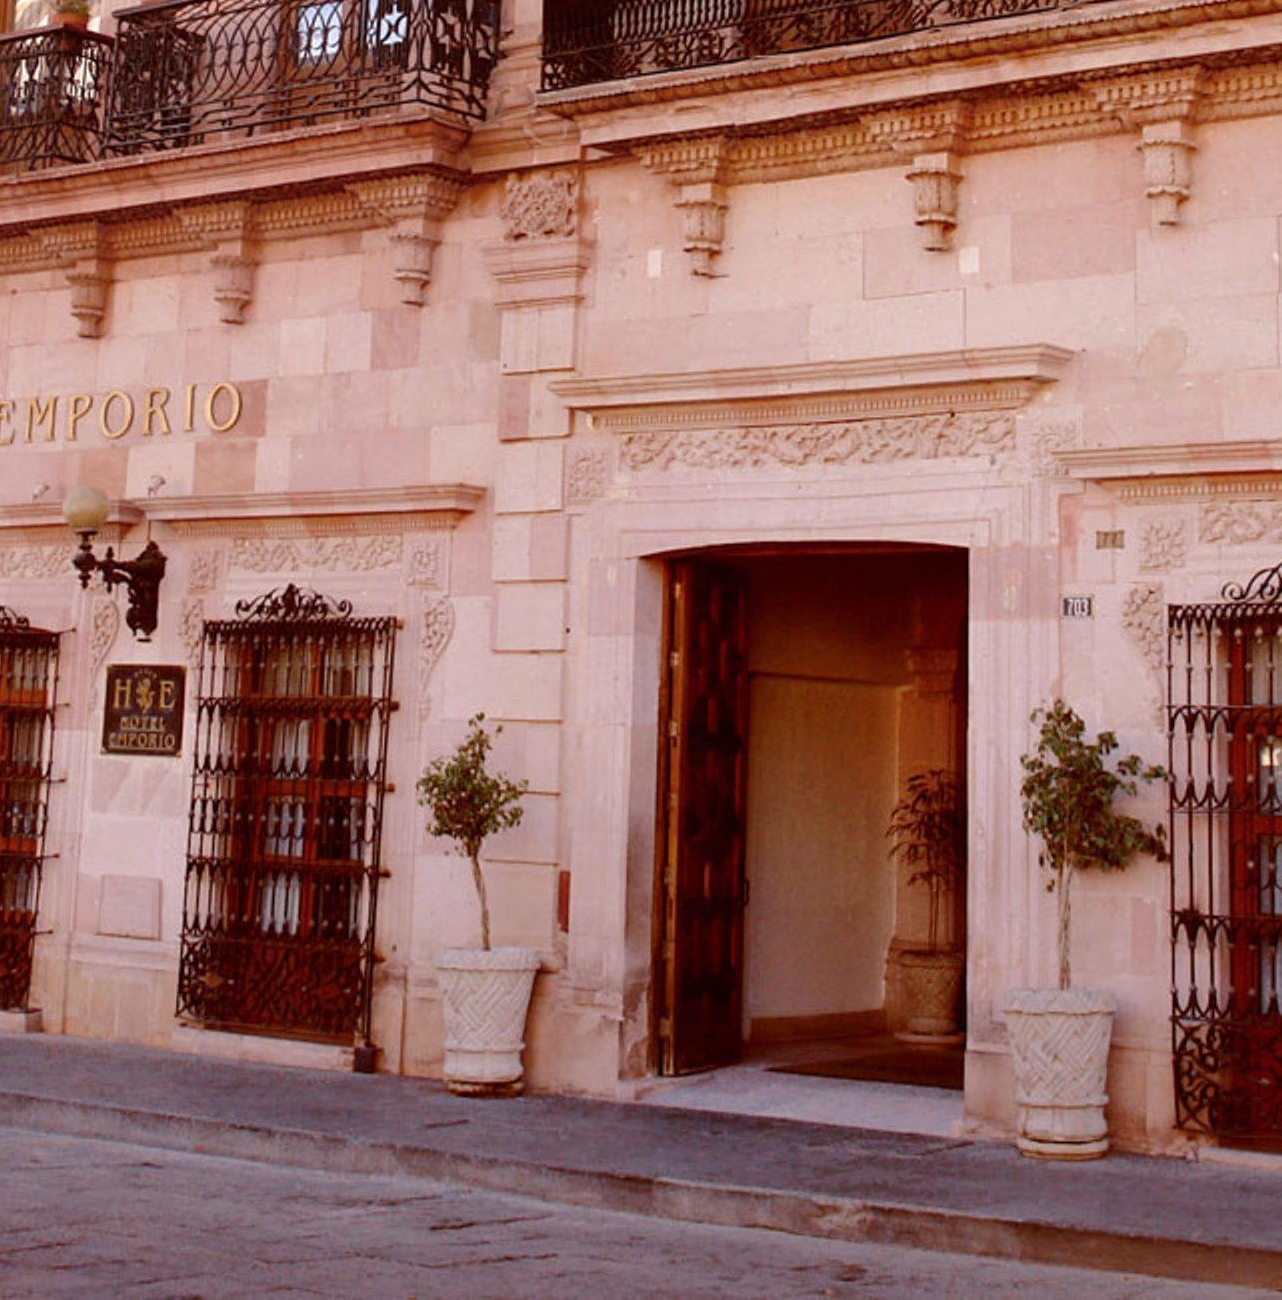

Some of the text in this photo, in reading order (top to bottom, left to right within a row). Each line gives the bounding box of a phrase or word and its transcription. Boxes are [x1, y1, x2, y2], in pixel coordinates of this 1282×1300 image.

[113, 679, 176, 710] H E
[120, 716, 166, 732] HOTEL
[108, 732, 175, 749] EMPORIO
